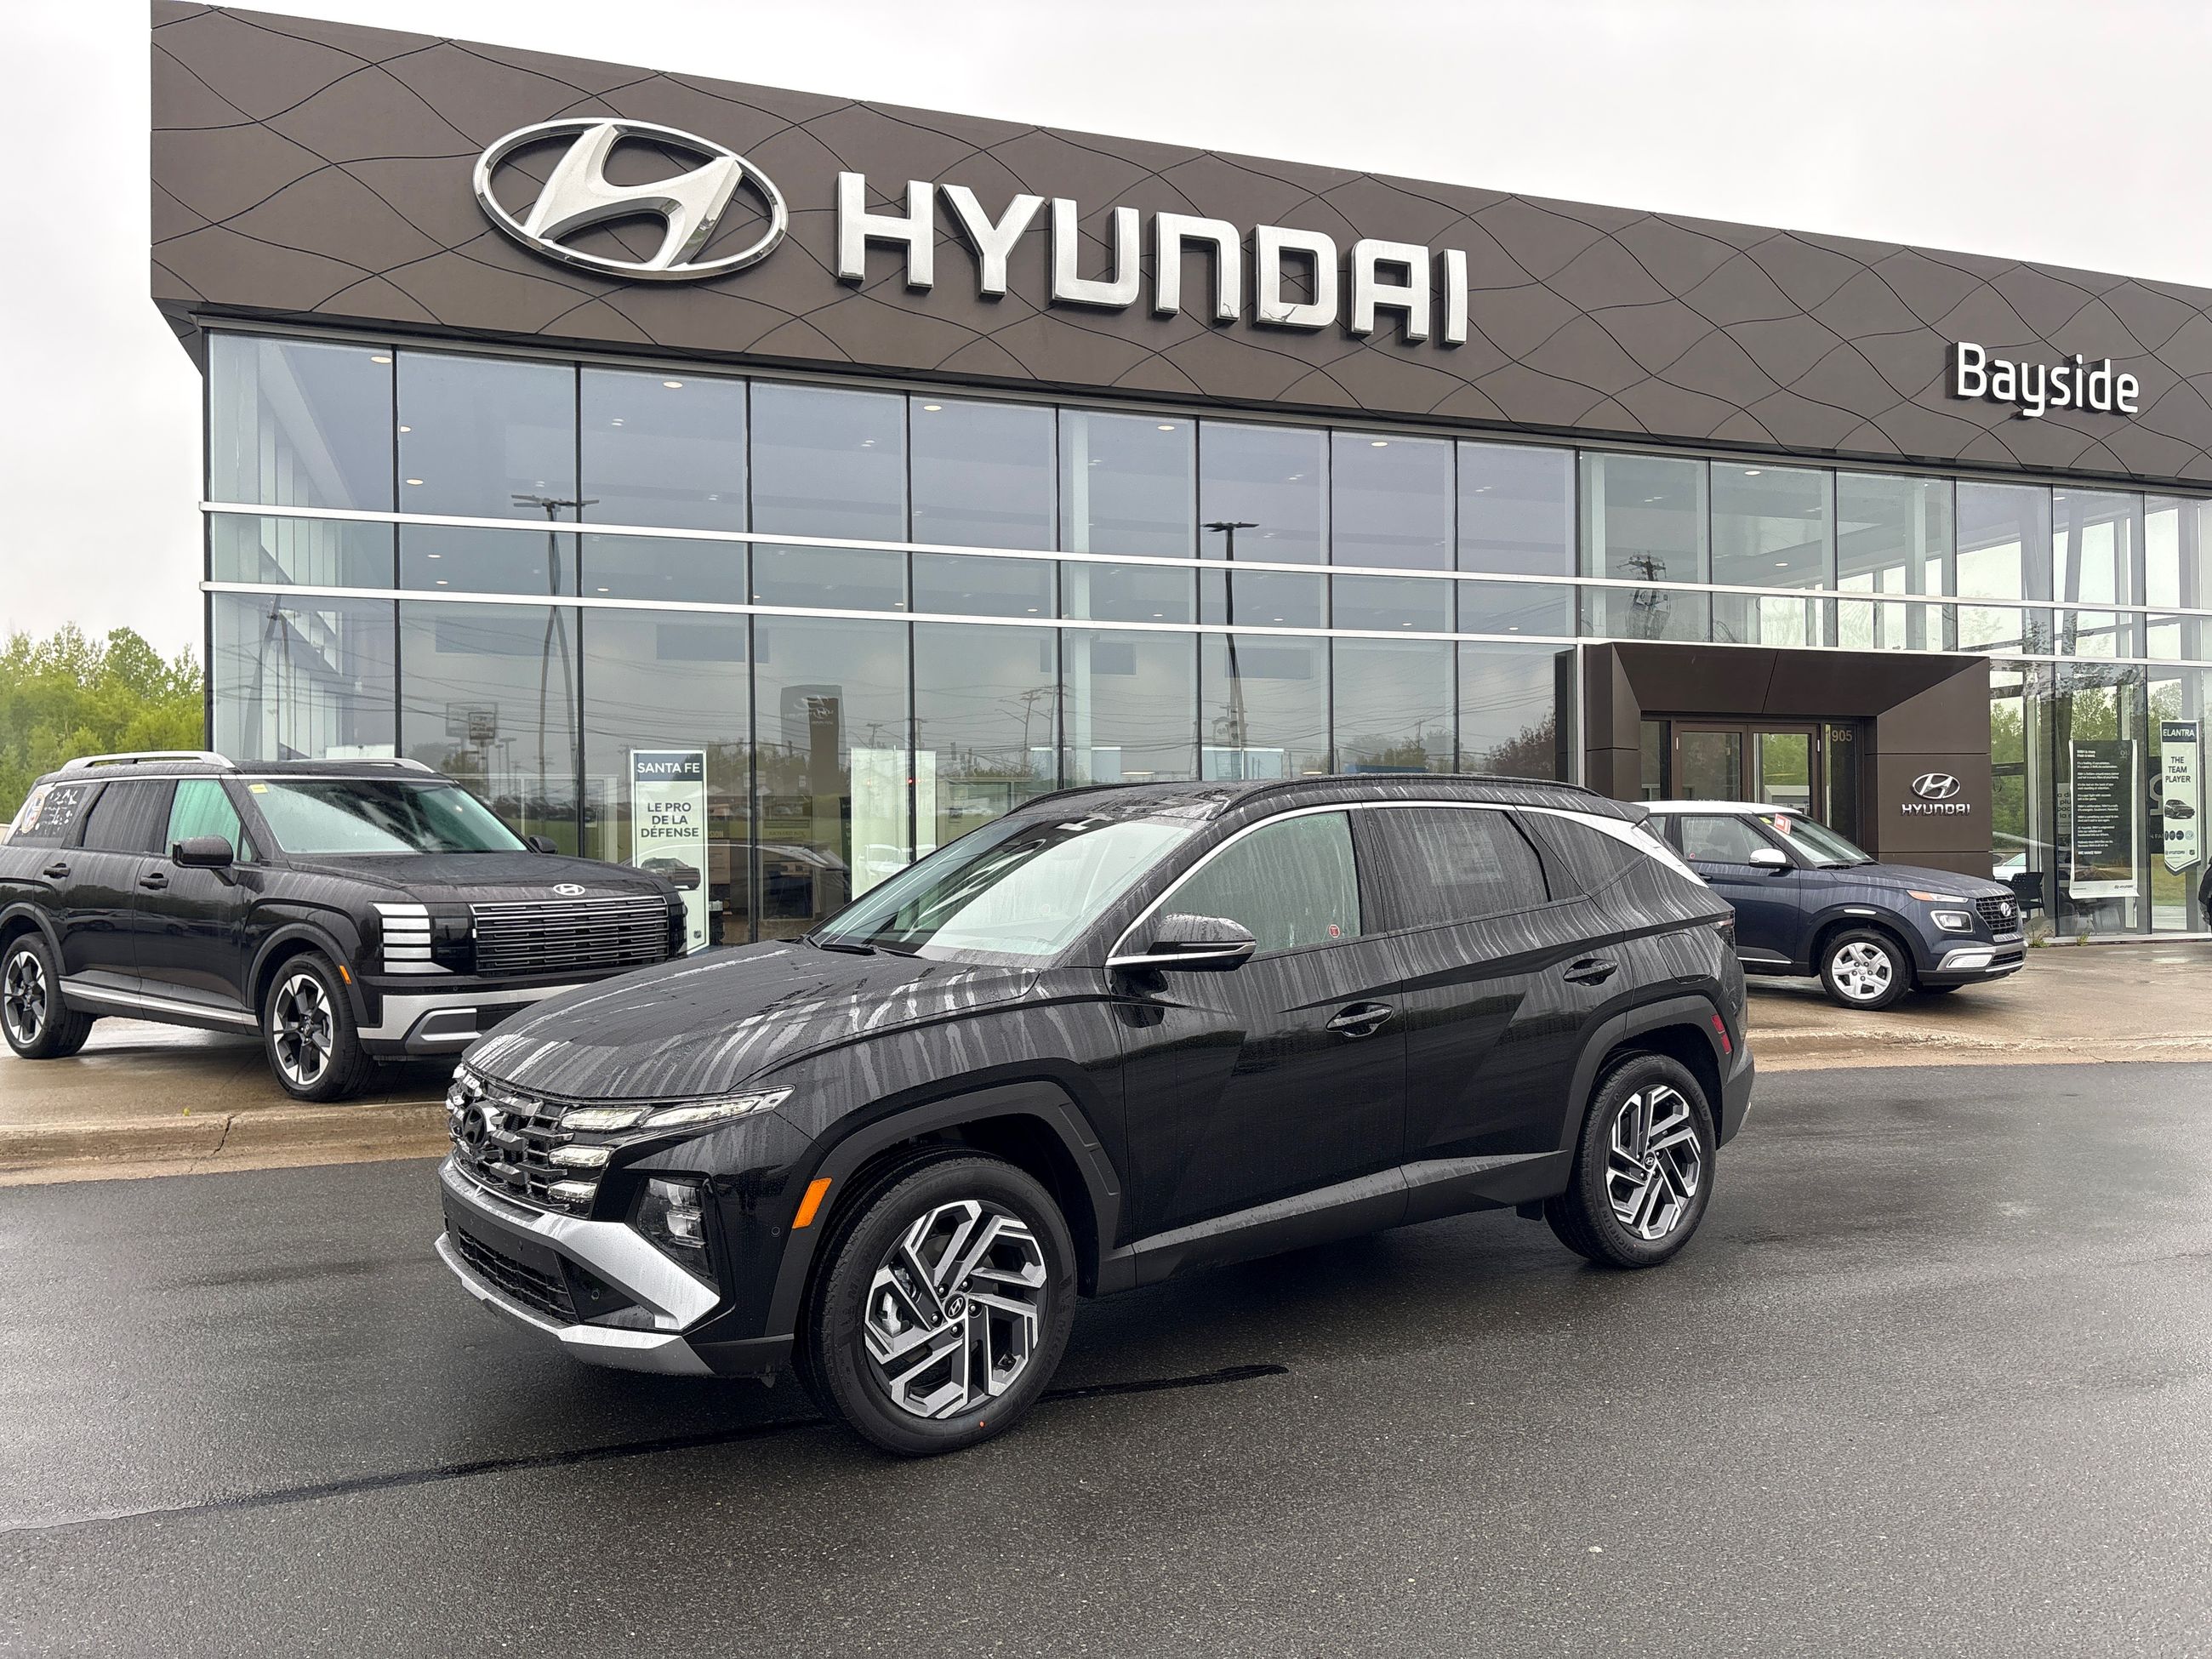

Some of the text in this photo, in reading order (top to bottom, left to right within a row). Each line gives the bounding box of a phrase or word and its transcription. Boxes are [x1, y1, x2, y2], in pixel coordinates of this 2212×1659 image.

[836, 170, 1468, 346] HYUNDAI
[1956, 340, 2141, 418] Bayside
[2163, 728, 2195, 737] ELANTRA
[2170, 755, 2185, 764] THE
[636, 762, 701, 773] SANTA FE
[2165, 775, 2192, 784] PLAYER
[647, 801, 692, 812] LE PRO
[1901, 803, 1971, 815] HYUNDAI
[652, 815, 688, 825] DE LA
[640, 825, 699, 838] DÉFENSE
